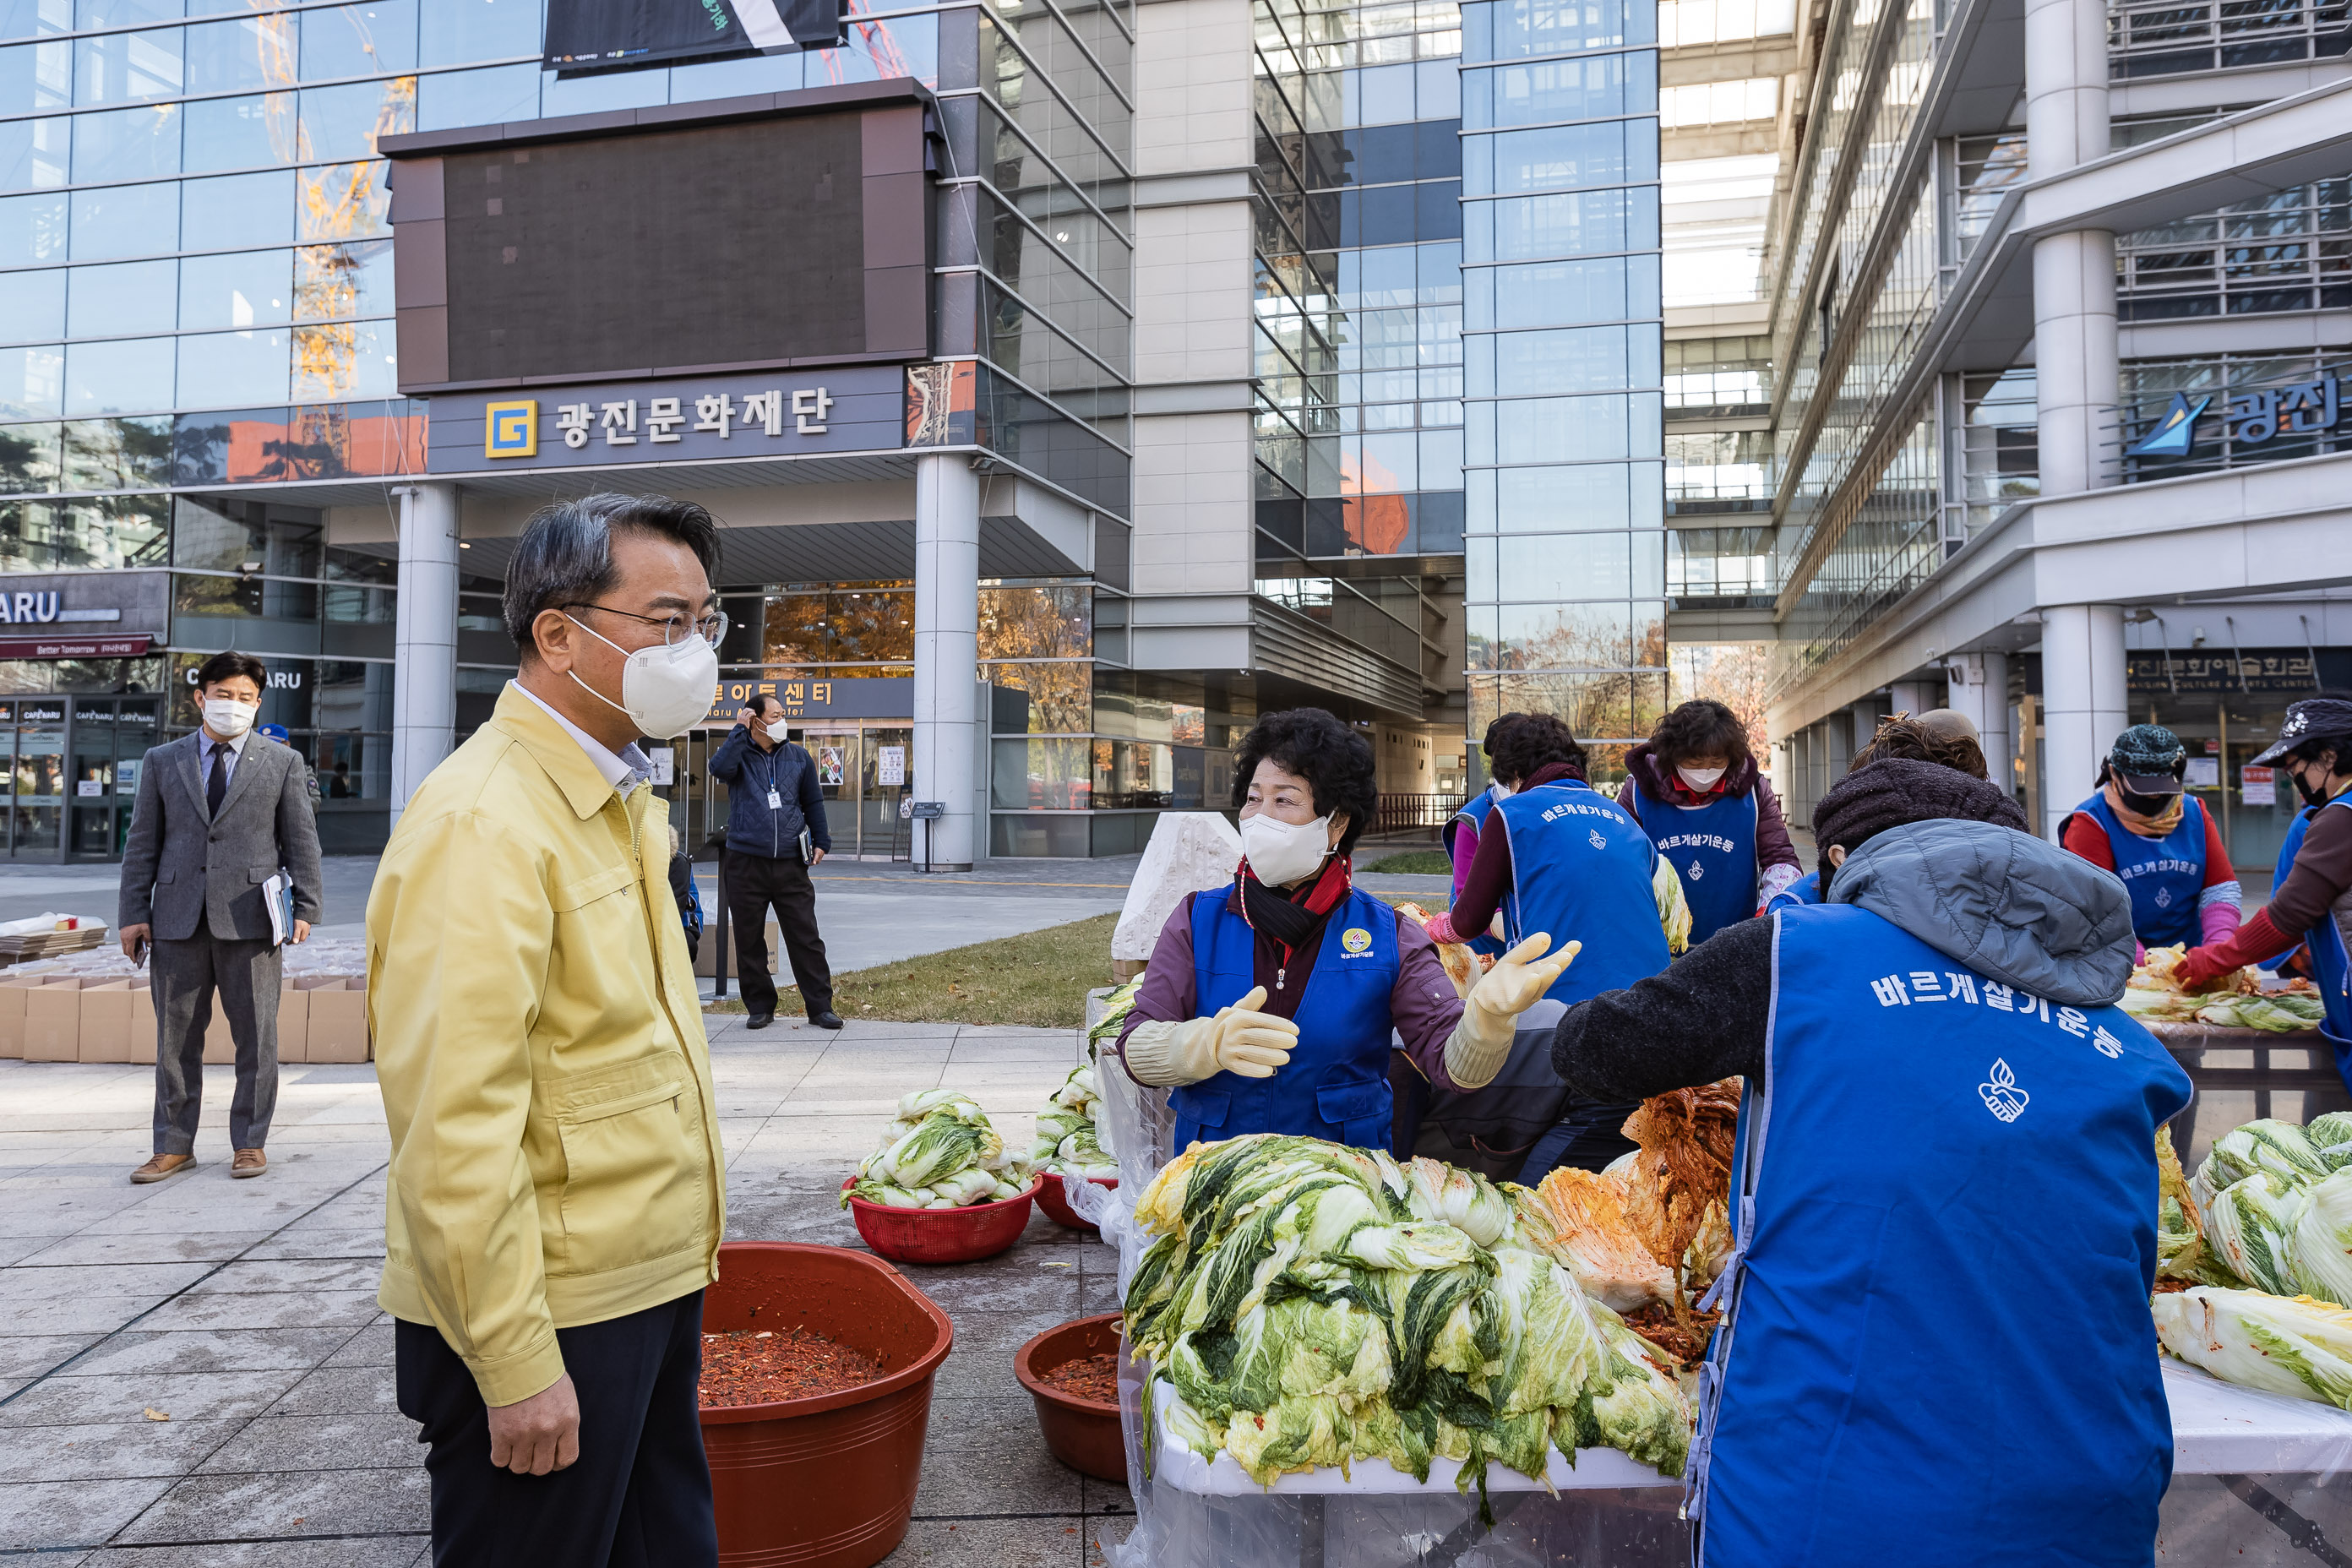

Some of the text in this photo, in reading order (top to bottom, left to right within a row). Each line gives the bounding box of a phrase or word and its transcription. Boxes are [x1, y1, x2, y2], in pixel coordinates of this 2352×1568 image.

[556, 387, 834, 449] 광진문화재단
[2224, 374, 2352, 443] 광진
[62, 645, 96, 655] Tomorrow
[1541, 803, 1625, 825] 바르게살기운동
[1658, 834, 1734, 853] 바르게살기운동
[2120, 859, 2198, 879] 바르게살기운동
[1870, 971, 2124, 1059] 바르게살기운동
